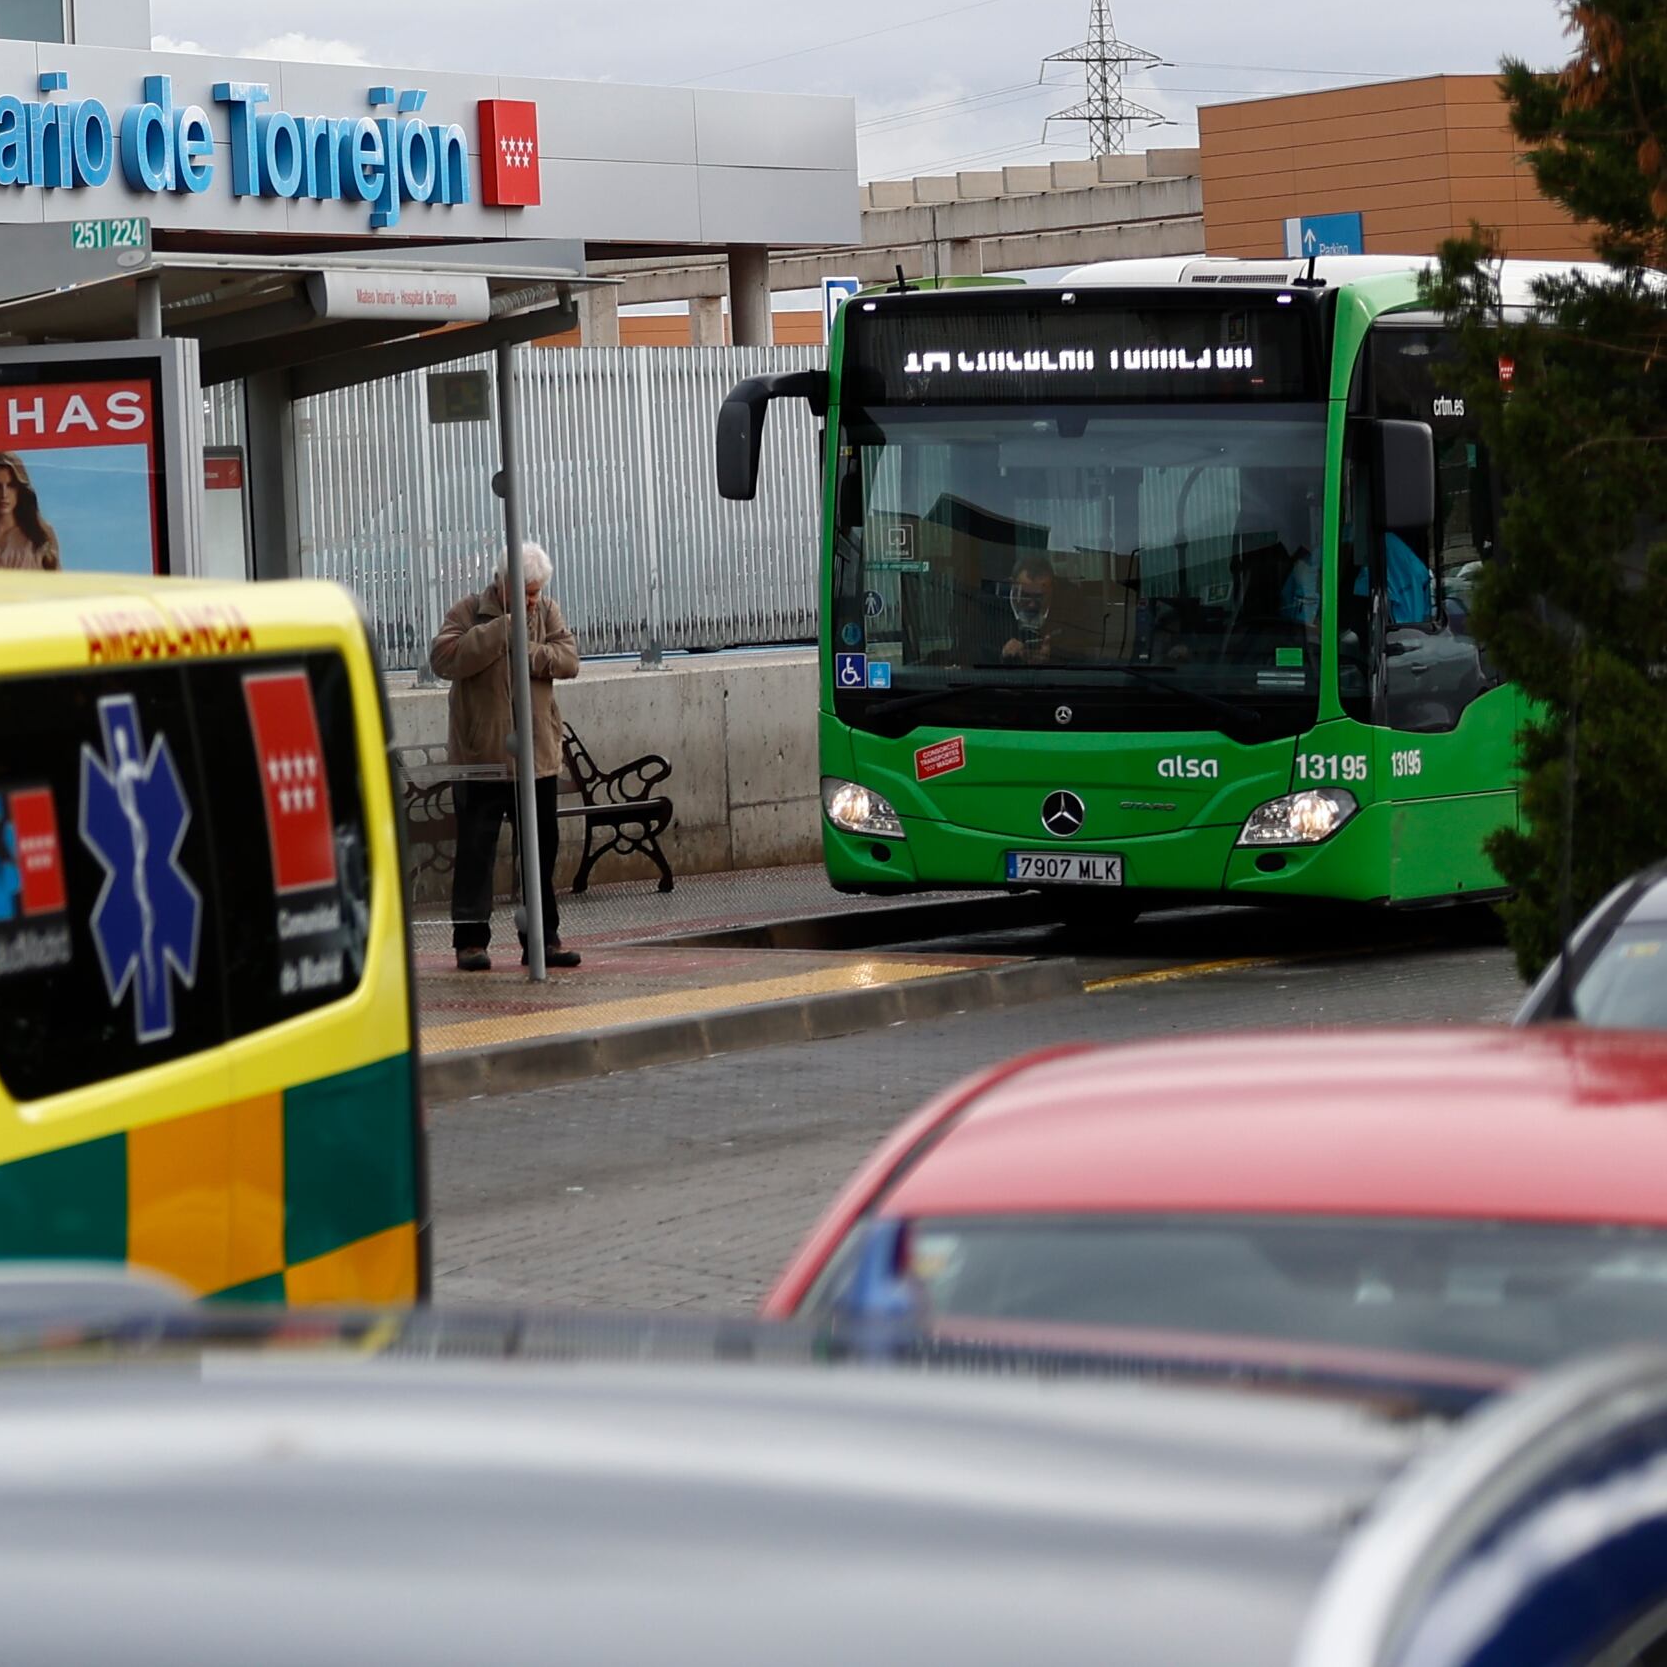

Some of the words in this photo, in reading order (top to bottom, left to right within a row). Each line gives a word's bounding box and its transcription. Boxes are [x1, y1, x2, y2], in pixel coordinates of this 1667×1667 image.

[122, 75, 214, 194] de
[213, 81, 470, 228] Torrejón
[74, 221, 103, 249] 251
[111, 219, 142, 246] 224
[1433, 395, 1465, 416] crtm.es
[79, 606, 256, 665] AMBULANCIA
[1157, 755, 1218, 778] alsa
[1296, 754, 1367, 780] 13195
[1391, 749, 1422, 777] 13195
[1021, 857, 1071, 878] 7907
[1079, 860, 1117, 880] MLK
